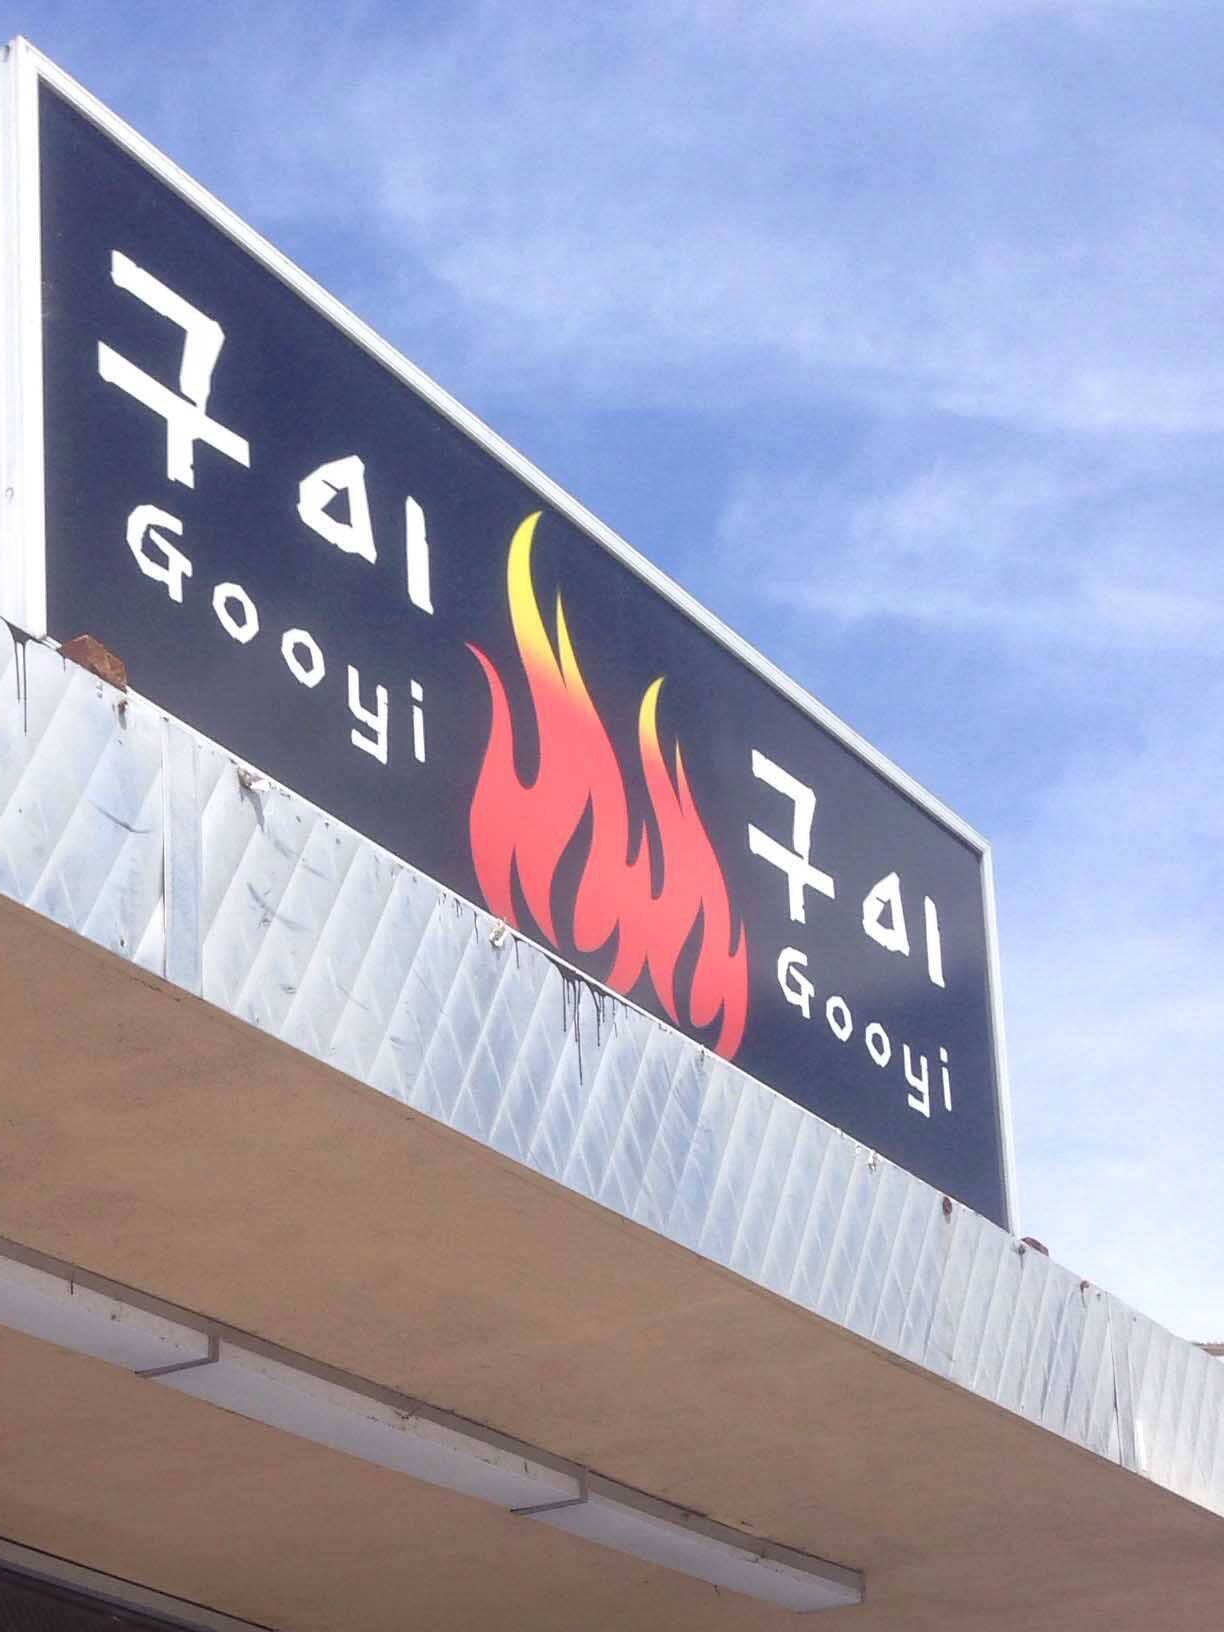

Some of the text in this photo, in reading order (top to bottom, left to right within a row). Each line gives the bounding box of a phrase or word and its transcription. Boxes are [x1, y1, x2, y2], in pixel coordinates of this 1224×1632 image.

[97, 250, 433, 614] 구이
[126, 503, 427, 764] Gooyi
[749, 749, 946, 988] 구이
[776, 947, 954, 1116] Gooyi
